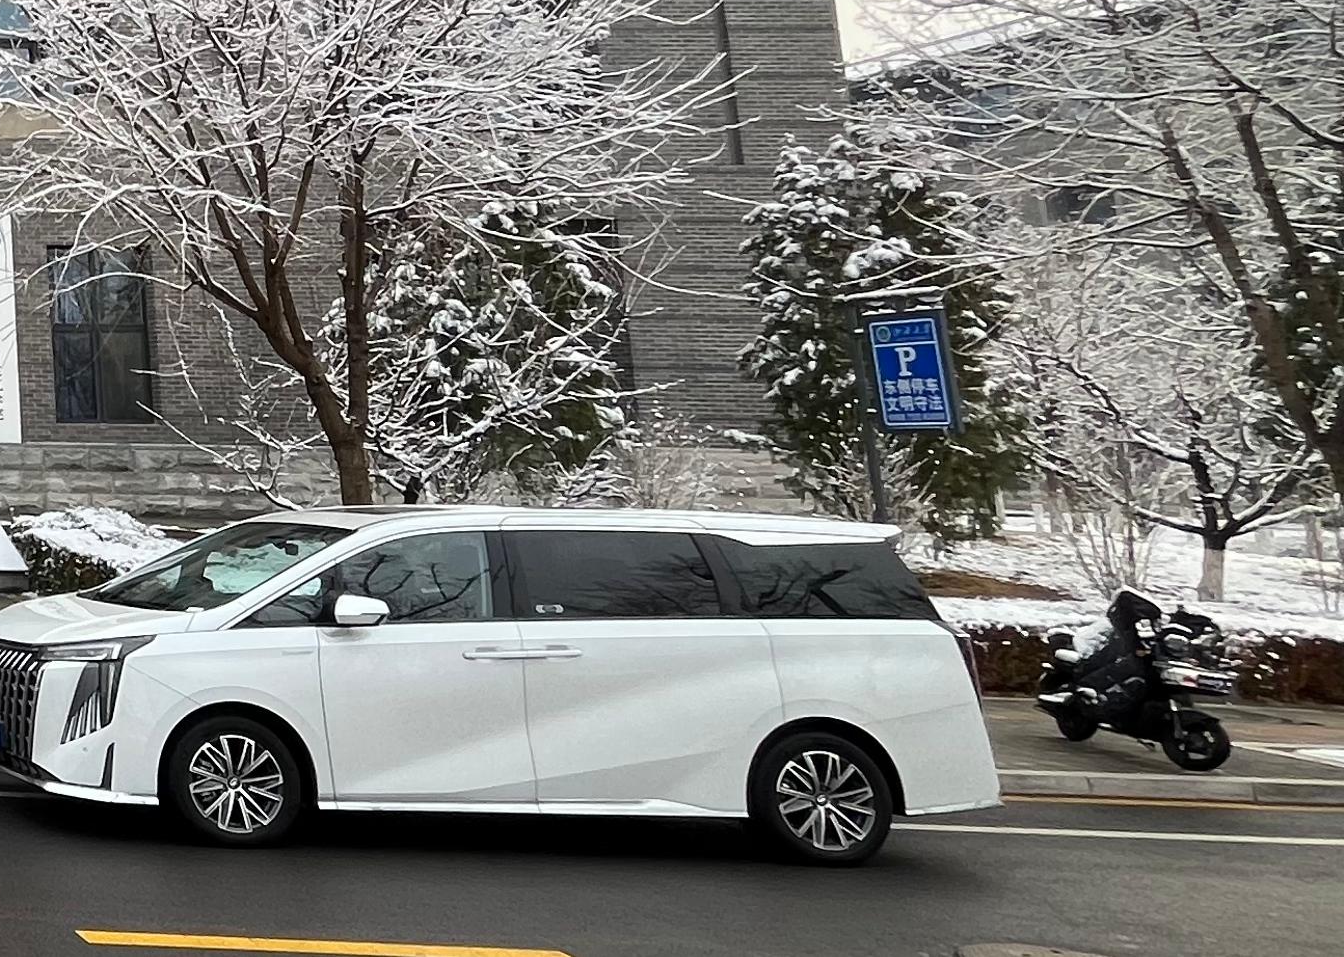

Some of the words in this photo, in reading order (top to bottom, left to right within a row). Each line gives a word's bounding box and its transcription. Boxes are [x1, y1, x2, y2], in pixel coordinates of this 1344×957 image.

[894, 346, 917, 377] P
[884, 395, 944, 412] 文明守法
